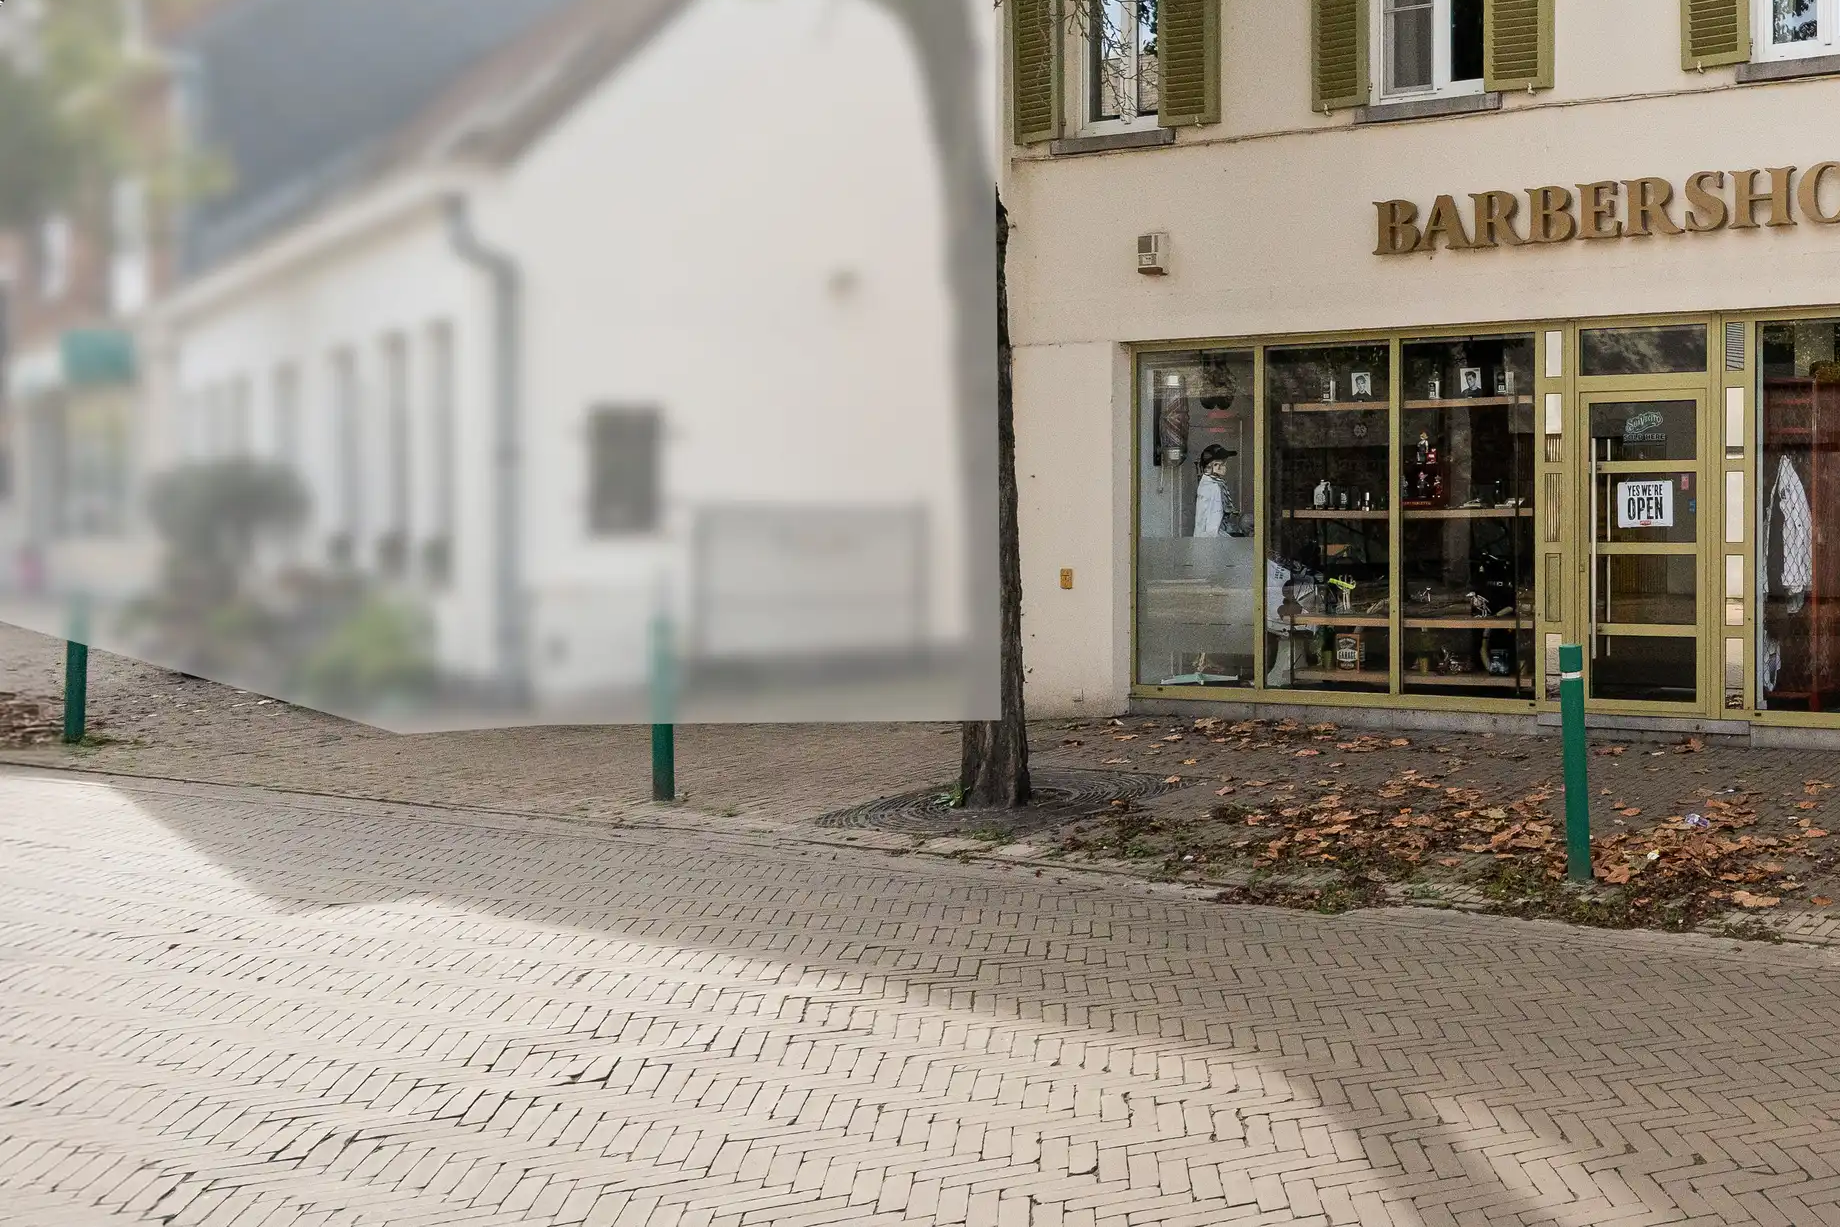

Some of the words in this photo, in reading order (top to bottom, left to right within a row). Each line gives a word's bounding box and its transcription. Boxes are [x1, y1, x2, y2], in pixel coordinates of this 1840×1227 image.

[1645, 433, 1666, 441] HERE
[1627, 484, 1640, 496] YES
[1641, 484, 1663, 496] WE'RE
[1627, 497, 1663, 520] OPEN
